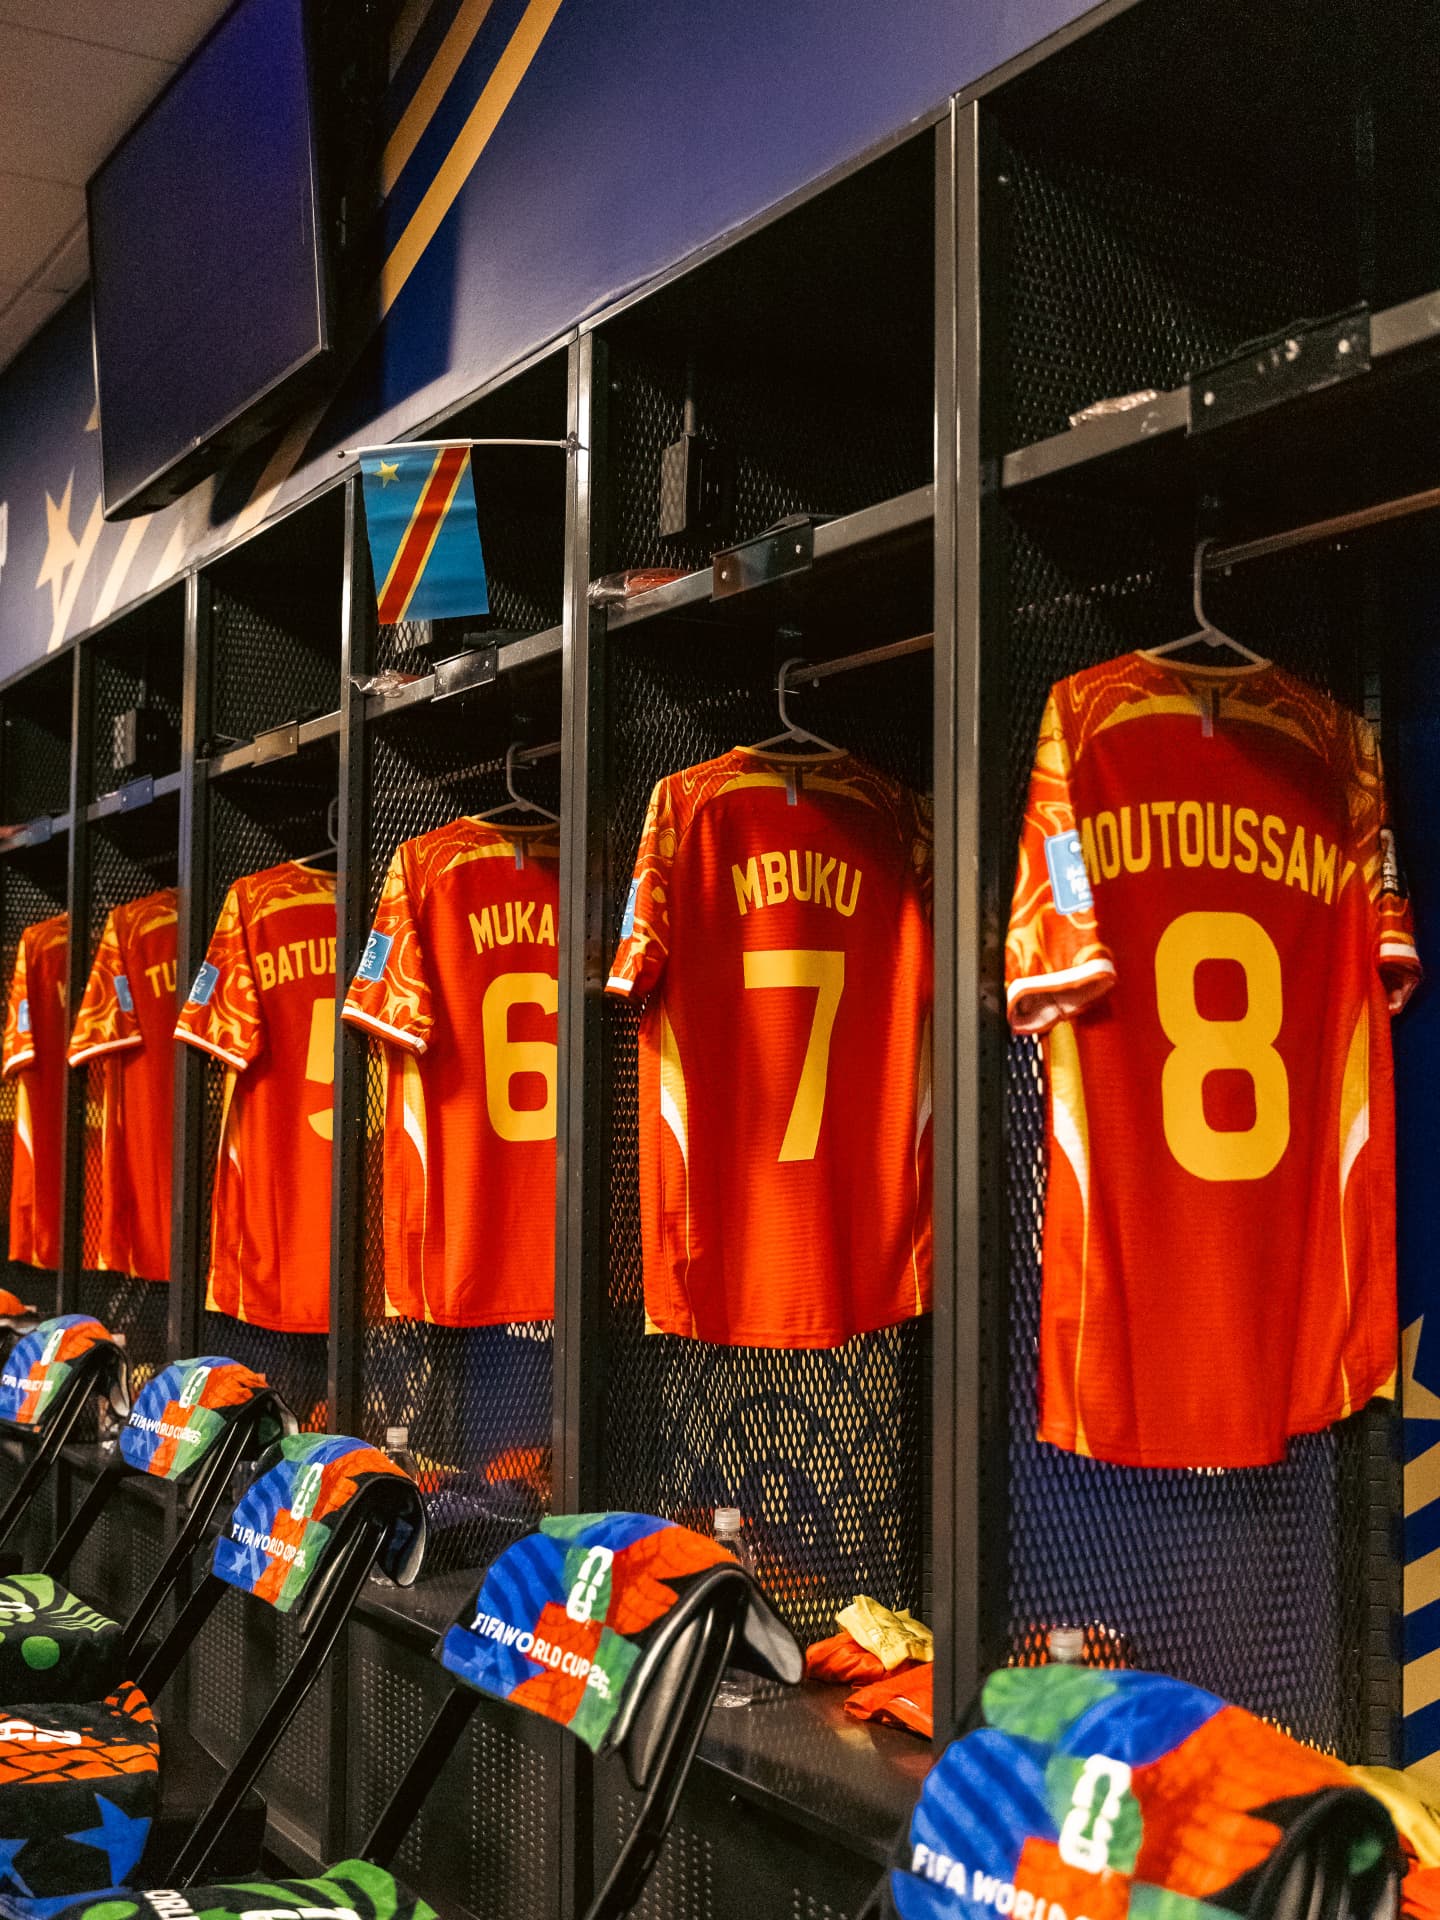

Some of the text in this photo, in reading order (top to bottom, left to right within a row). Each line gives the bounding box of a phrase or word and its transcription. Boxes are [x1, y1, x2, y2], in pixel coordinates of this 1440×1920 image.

[731, 849, 862, 917] MBUKU
[468, 900, 559, 955] MUKA
[482, 972, 559, 1142] 6
[743, 949, 845, 1162] 7
[1154, 911, 1291, 1182] 8
[231, 1522, 255, 1545] FIFA
[254, 1532, 285, 1556] WORLD
[470, 1612, 506, 1643] FIFA
[501, 1625, 563, 1668] WORLD
[561, 1651, 592, 1680] CUP
[911, 1842, 967, 1896] FIFA
